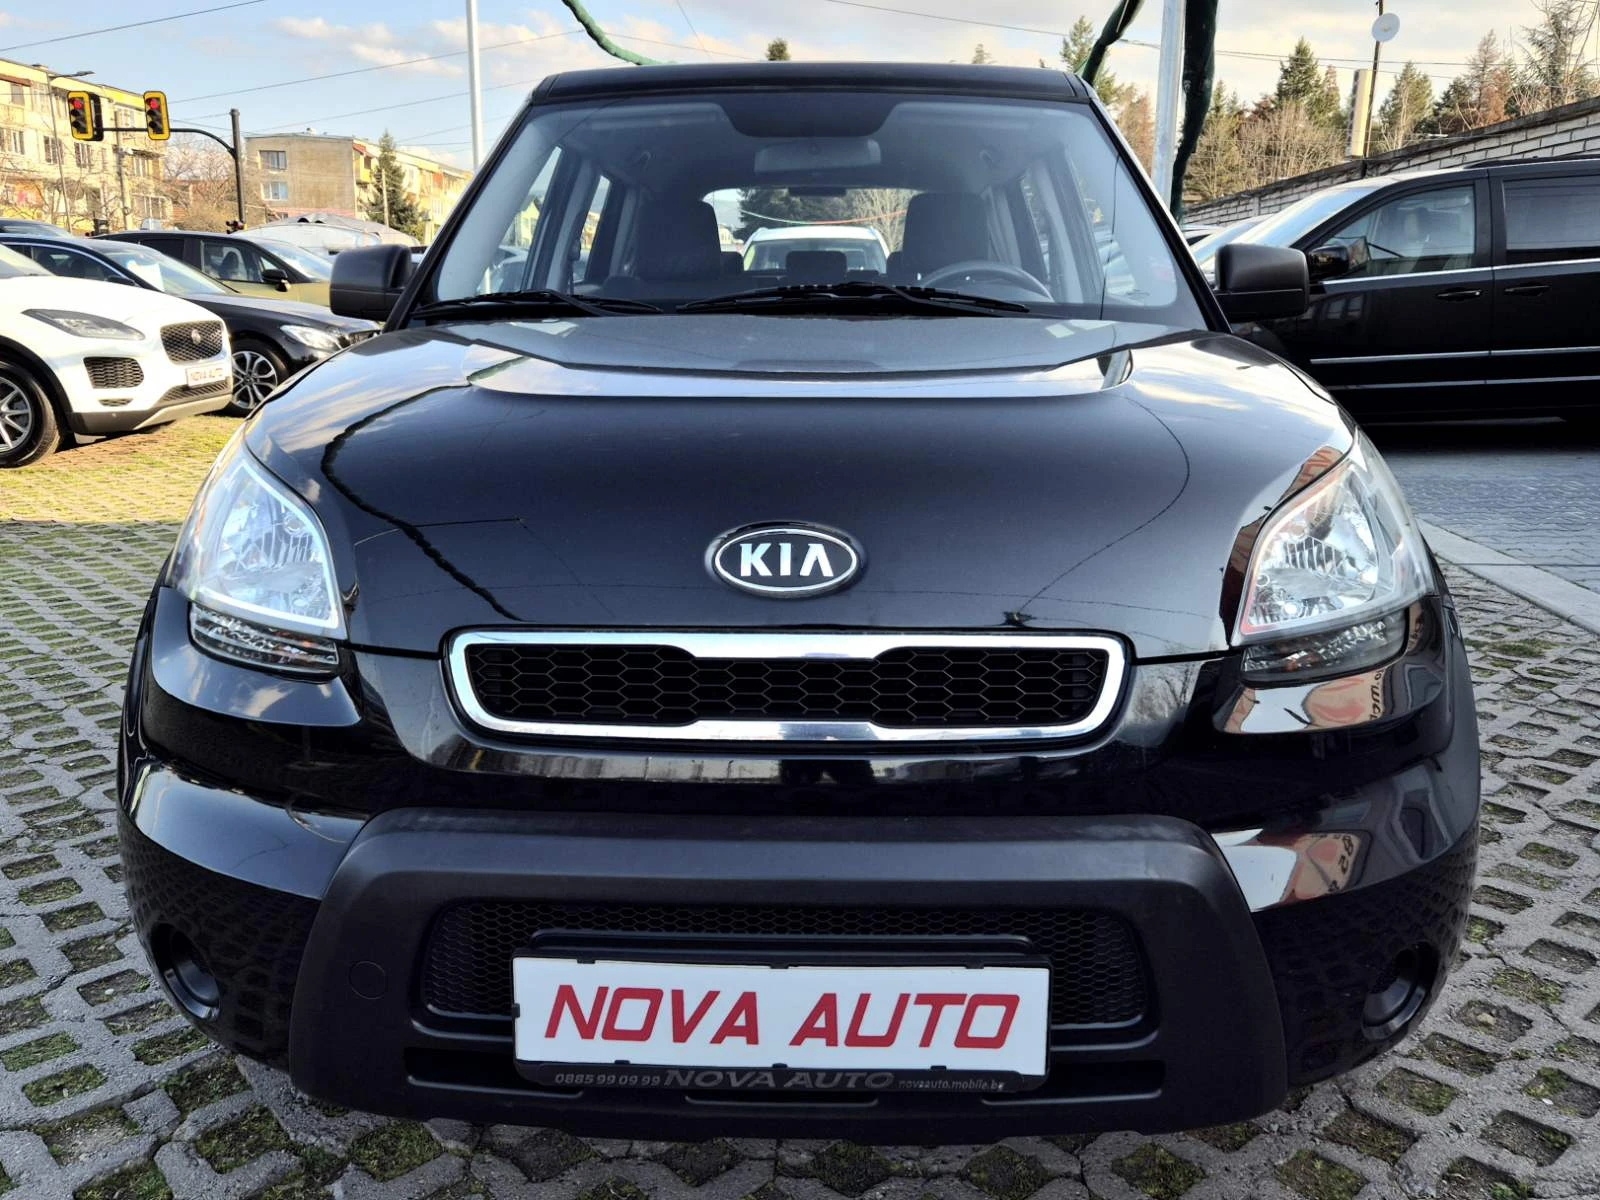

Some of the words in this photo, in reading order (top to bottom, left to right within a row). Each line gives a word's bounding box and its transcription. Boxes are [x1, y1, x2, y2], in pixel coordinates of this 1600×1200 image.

[740, 542, 834, 577] KIA
[545, 984, 759, 1046] NOVA
[789, 992, 1020, 1049] AUTO
[555, 1073, 594, 1085] 0885
[663, 1070, 776, 1088] NOVA
[784, 1072, 894, 1089] AUTO
